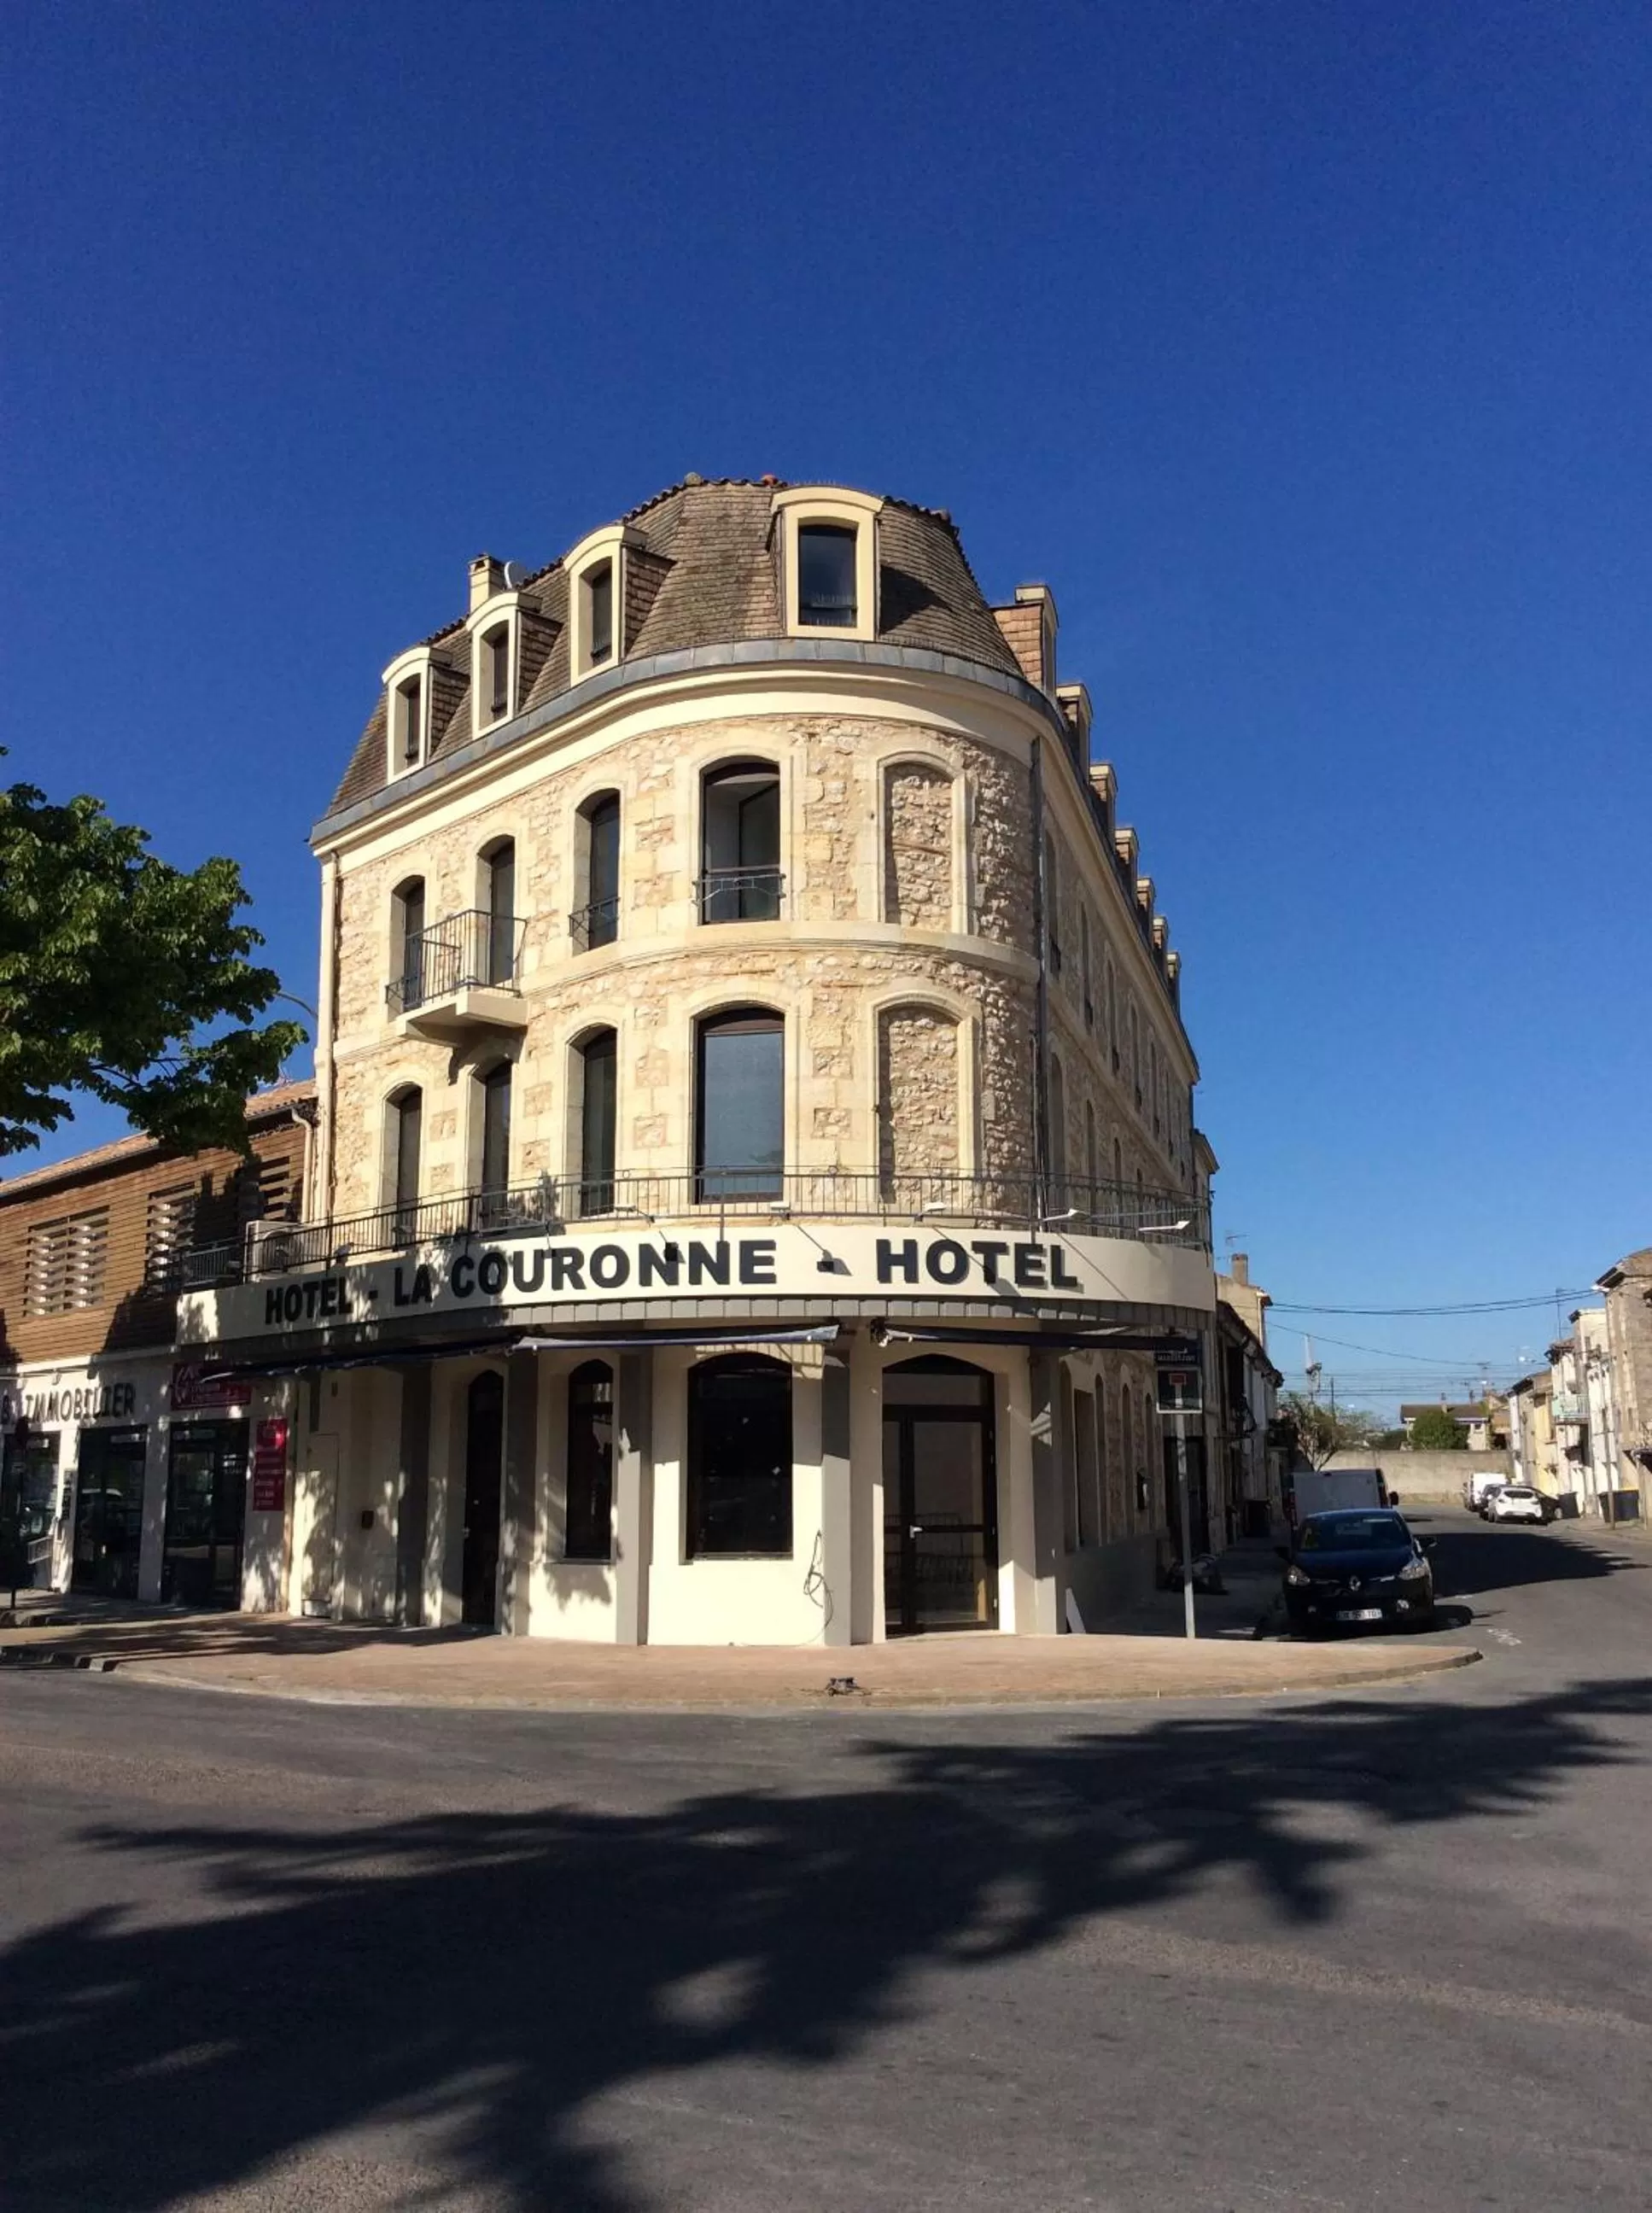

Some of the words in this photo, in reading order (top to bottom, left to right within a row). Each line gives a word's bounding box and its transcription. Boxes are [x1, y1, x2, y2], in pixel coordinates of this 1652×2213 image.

[265, 1276, 353, 1325] HOTEL
[394, 1262, 432, 1306] LA
[451, 1239, 777, 1299] COURONNE
[876, 1238, 1078, 1288] HOTEL
[25, 1381, 136, 1423] IMMOBILIER
